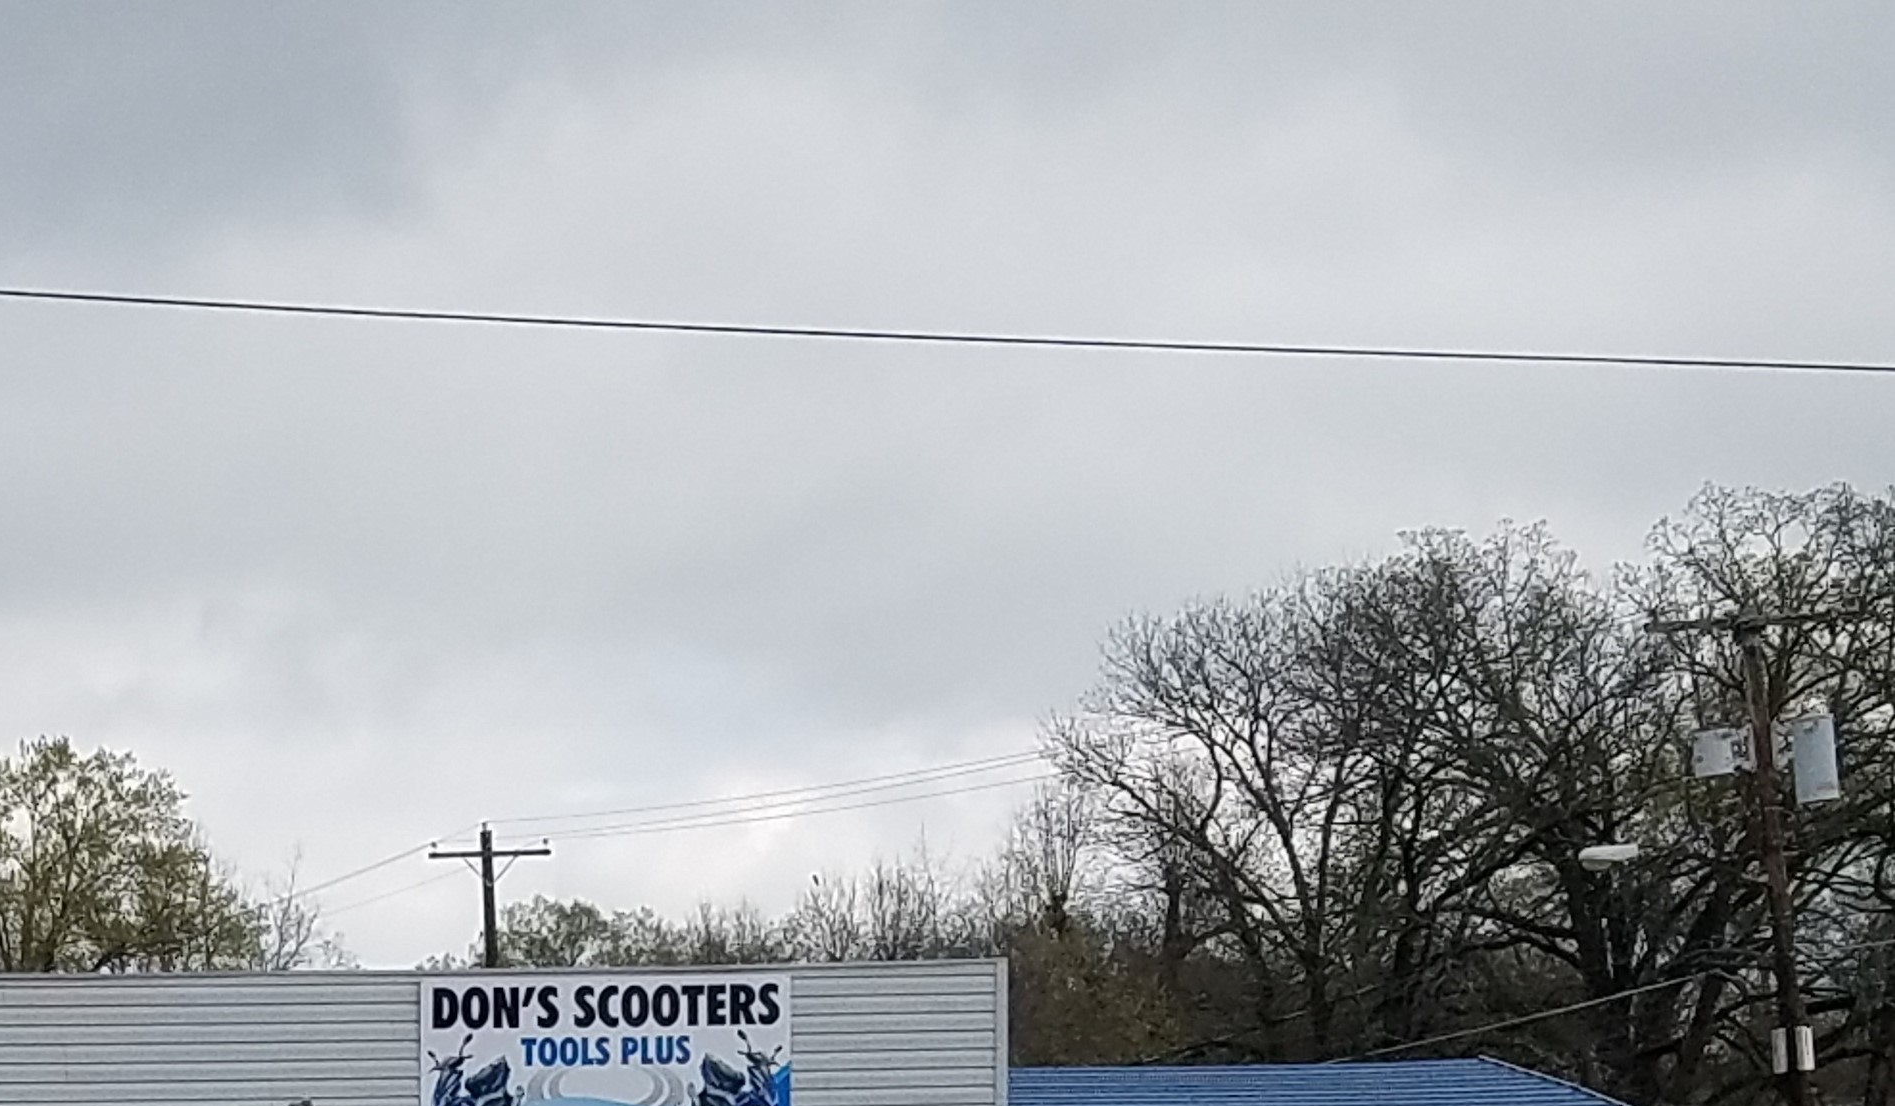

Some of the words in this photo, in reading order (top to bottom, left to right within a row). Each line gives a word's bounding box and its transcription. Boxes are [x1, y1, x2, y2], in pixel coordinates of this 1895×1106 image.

[431, 986, 559, 1029] DON'S
[573, 983, 781, 1028] SCOOTERS
[521, 1037, 610, 1066] TOOLS
[620, 1035, 691, 1065] PLUS
